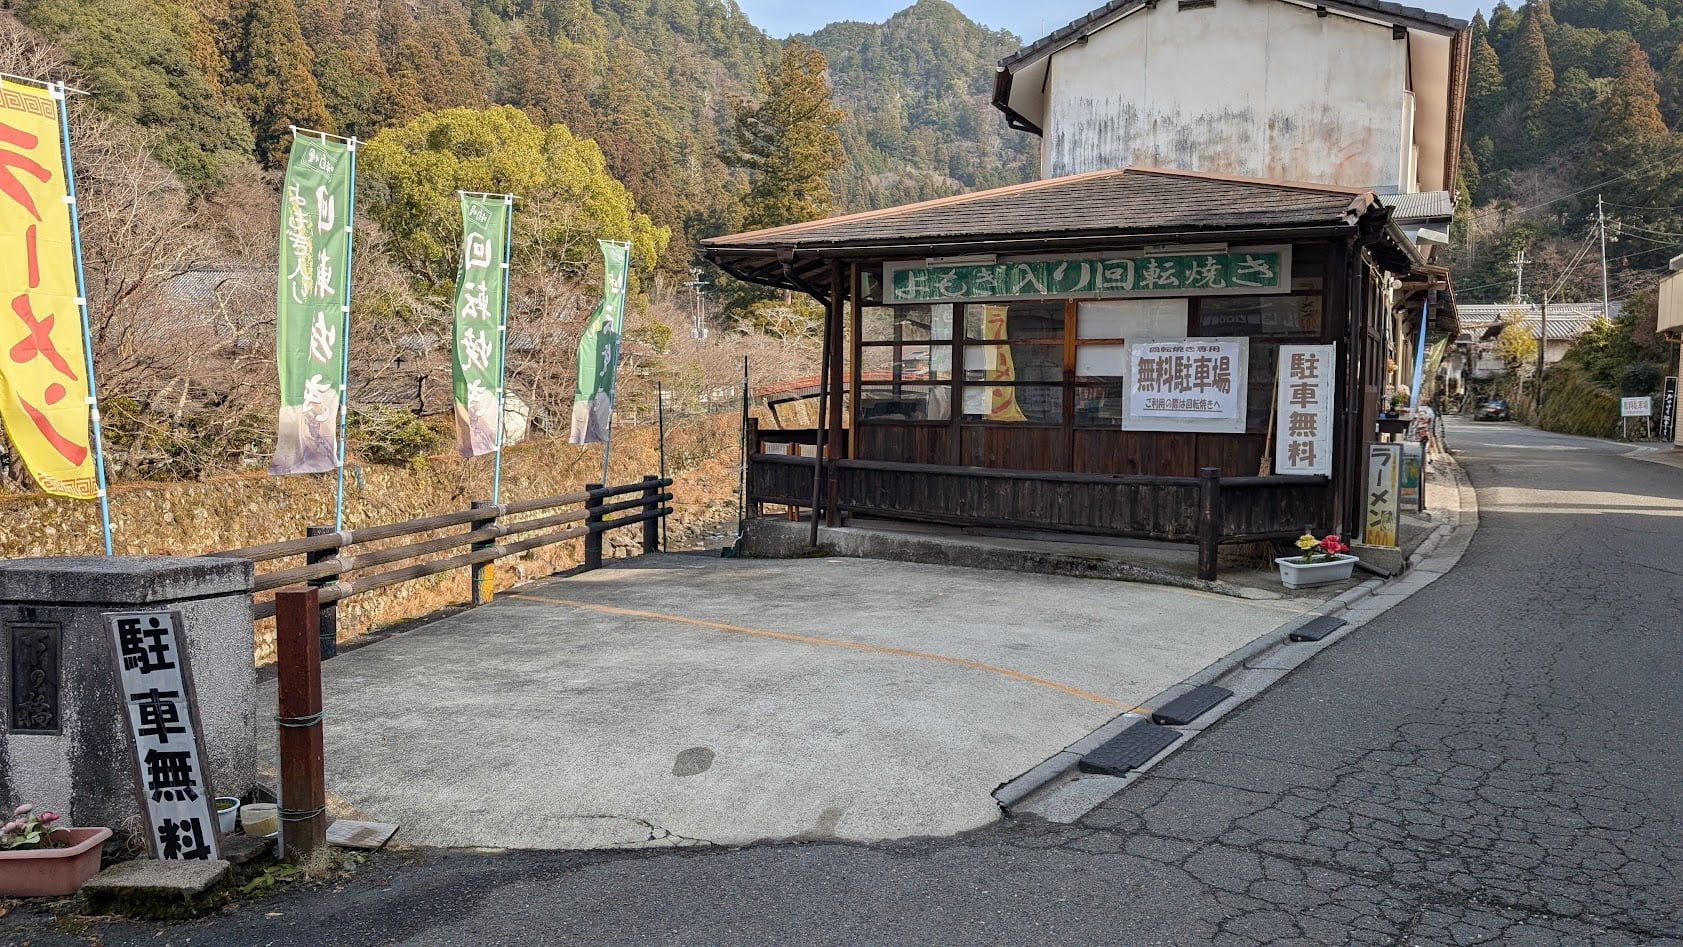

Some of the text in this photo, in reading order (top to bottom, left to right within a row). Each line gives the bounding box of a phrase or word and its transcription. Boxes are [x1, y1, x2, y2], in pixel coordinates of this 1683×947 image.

[895, 254, 1274, 299] よもぎ入り回転焼き
[1149, 345, 1220, 353] 回転焼き専用
[1138, 356, 1231, 394] 無料駐車場
[1145, 398, 1221, 410] ご利用の際は回転焼きへ
[1288, 353, 1319, 467] 駐車無料
[1369, 448, 1391, 528] ラーメン
[117, 617, 211, 860] 駐車無料
